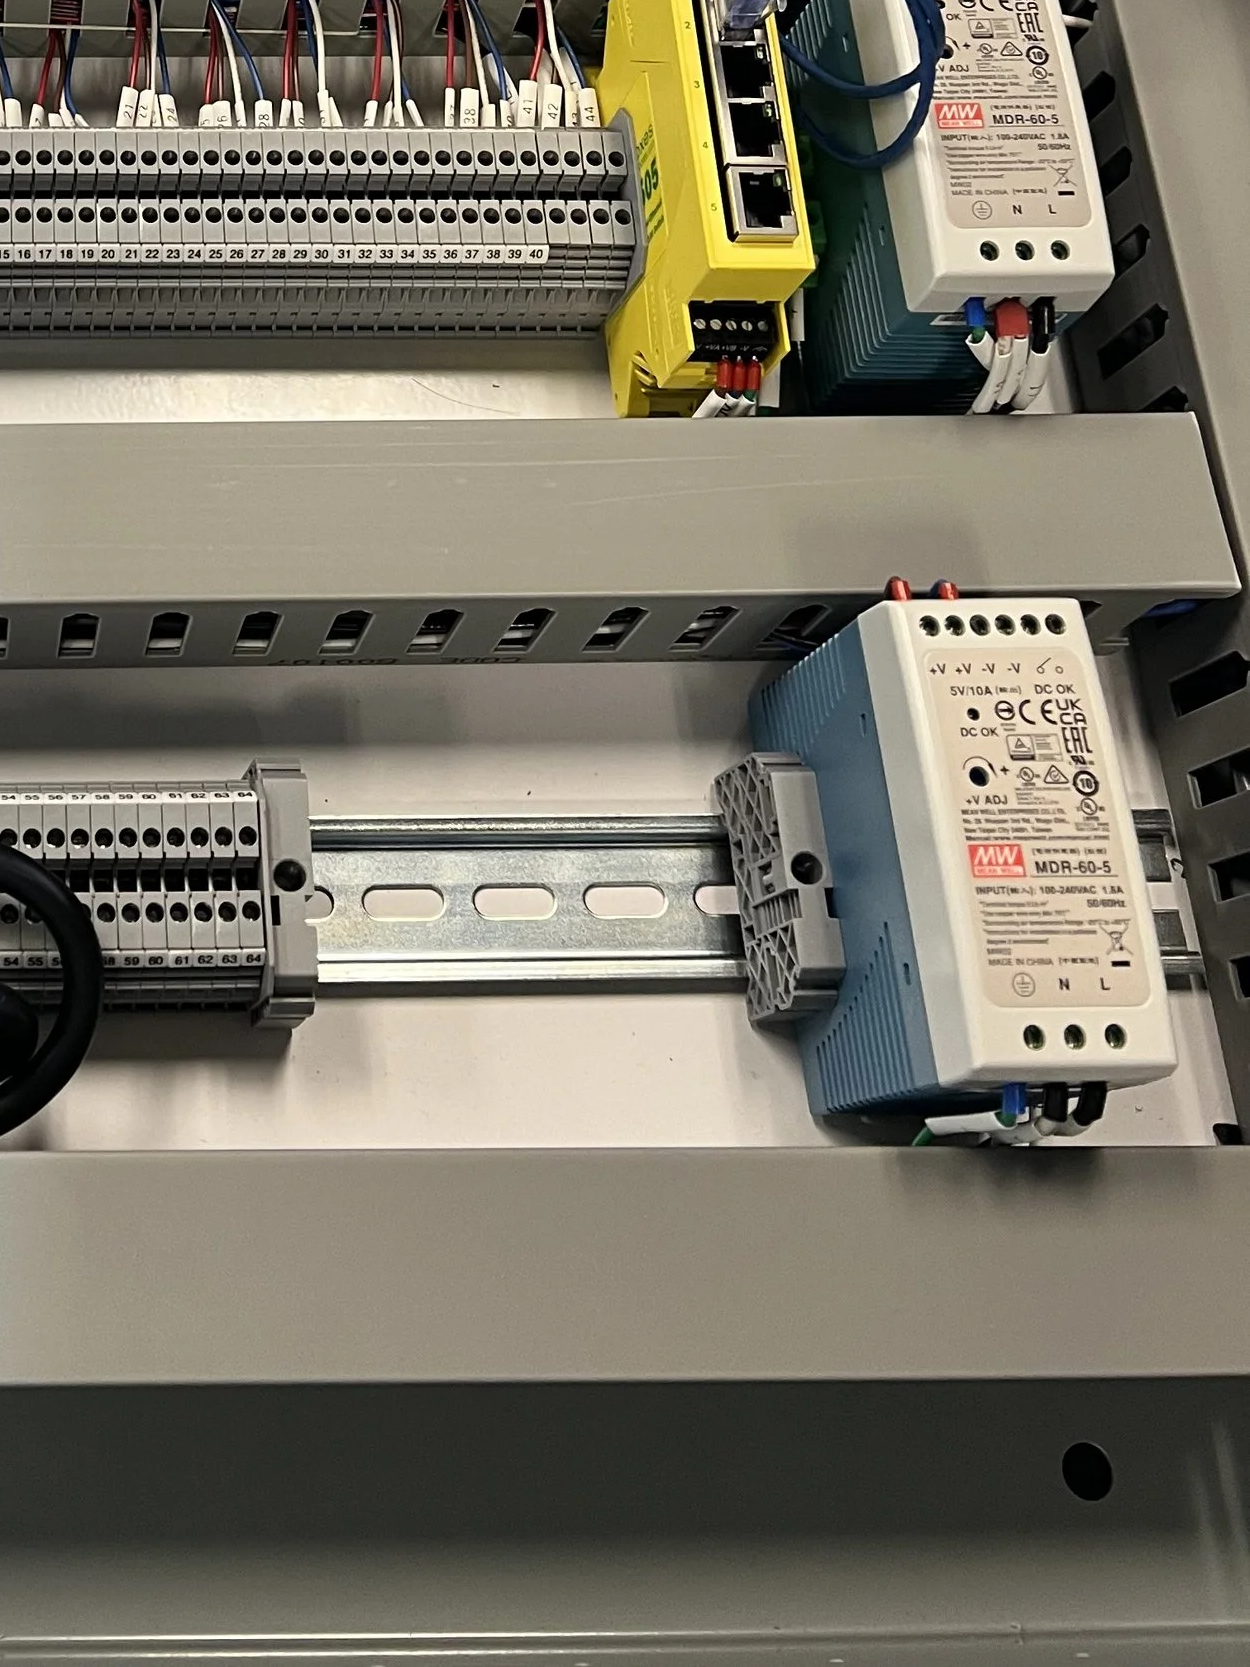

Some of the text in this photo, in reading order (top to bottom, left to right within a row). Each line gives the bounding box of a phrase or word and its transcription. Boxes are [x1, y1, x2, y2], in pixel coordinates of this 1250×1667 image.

[1015, 1, 1039, 12] CA
[684, 21, 691, 30] 2
[949, 64, 969, 73] ADJ
[694, 80, 700, 89] 3
[523, 99, 533, 114] 41
[547, 103, 559, 120] 42
[584, 106, 594, 122] 44
[992, 114, 1060, 125] MDR-60-5
[702, 141, 708, 149] 4
[711, 203, 717, 211] 5
[1012, 204, 1057, 214] N L
[19, 250, 31, 259] 16
[39, 250, 52, 258] 17
[61, 250, 72, 258] 18
[82, 249, 94, 258] 19
[102, 249, 114, 258] 20
[126, 249, 137, 258] 21
[146, 249, 159, 258] 22
[167, 249, 180, 259] 23
[188, 250, 201, 258] 24
[209, 250, 222, 258] 25
[230, 250, 243, 258] 26
[251, 250, 264, 258] 27
[272, 250, 285, 259] 28
[293, 250, 307, 258] 29
[315, 250, 328, 259] 30
[338, 250, 350, 258] 31
[358, 250, 372, 258] 32
[380, 250, 393, 258] 33
[401, 250, 414, 259] 34
[423, 250, 436, 259] 35
[444, 250, 457, 259] 36
[465, 250, 479, 259] 37
[487, 250, 500, 259] 38
[508, 250, 521, 258] 39
[530, 250, 543, 258] 40
[929, 663, 1021, 675] +V +V -V -V
[950, 685, 993, 696] 5V/10A
[1034, 684, 1053, 695] DC
[1056, 684, 1076, 695] OK
[1055, 698, 1083, 711] UK
[1018, 699, 1058, 725] CE
[1059, 712, 1088, 725] CA
[960, 727, 999, 737] DC OK
[966, 795, 980, 805] +V
[984, 795, 1008, 805] ADJ
[1034, 860, 1112, 875] MDR-60-5
[3, 957, 19, 966] 54
[27, 956, 43, 966] 55
[123, 955, 139, 966] 59
[148, 955, 164, 965] 60
[174, 955, 189, 965] 61
[197, 955, 213, 964] 62
[221, 954, 237, 964] 63
[246, 954, 261, 963] 64
[1059, 978, 1111, 991] N L
